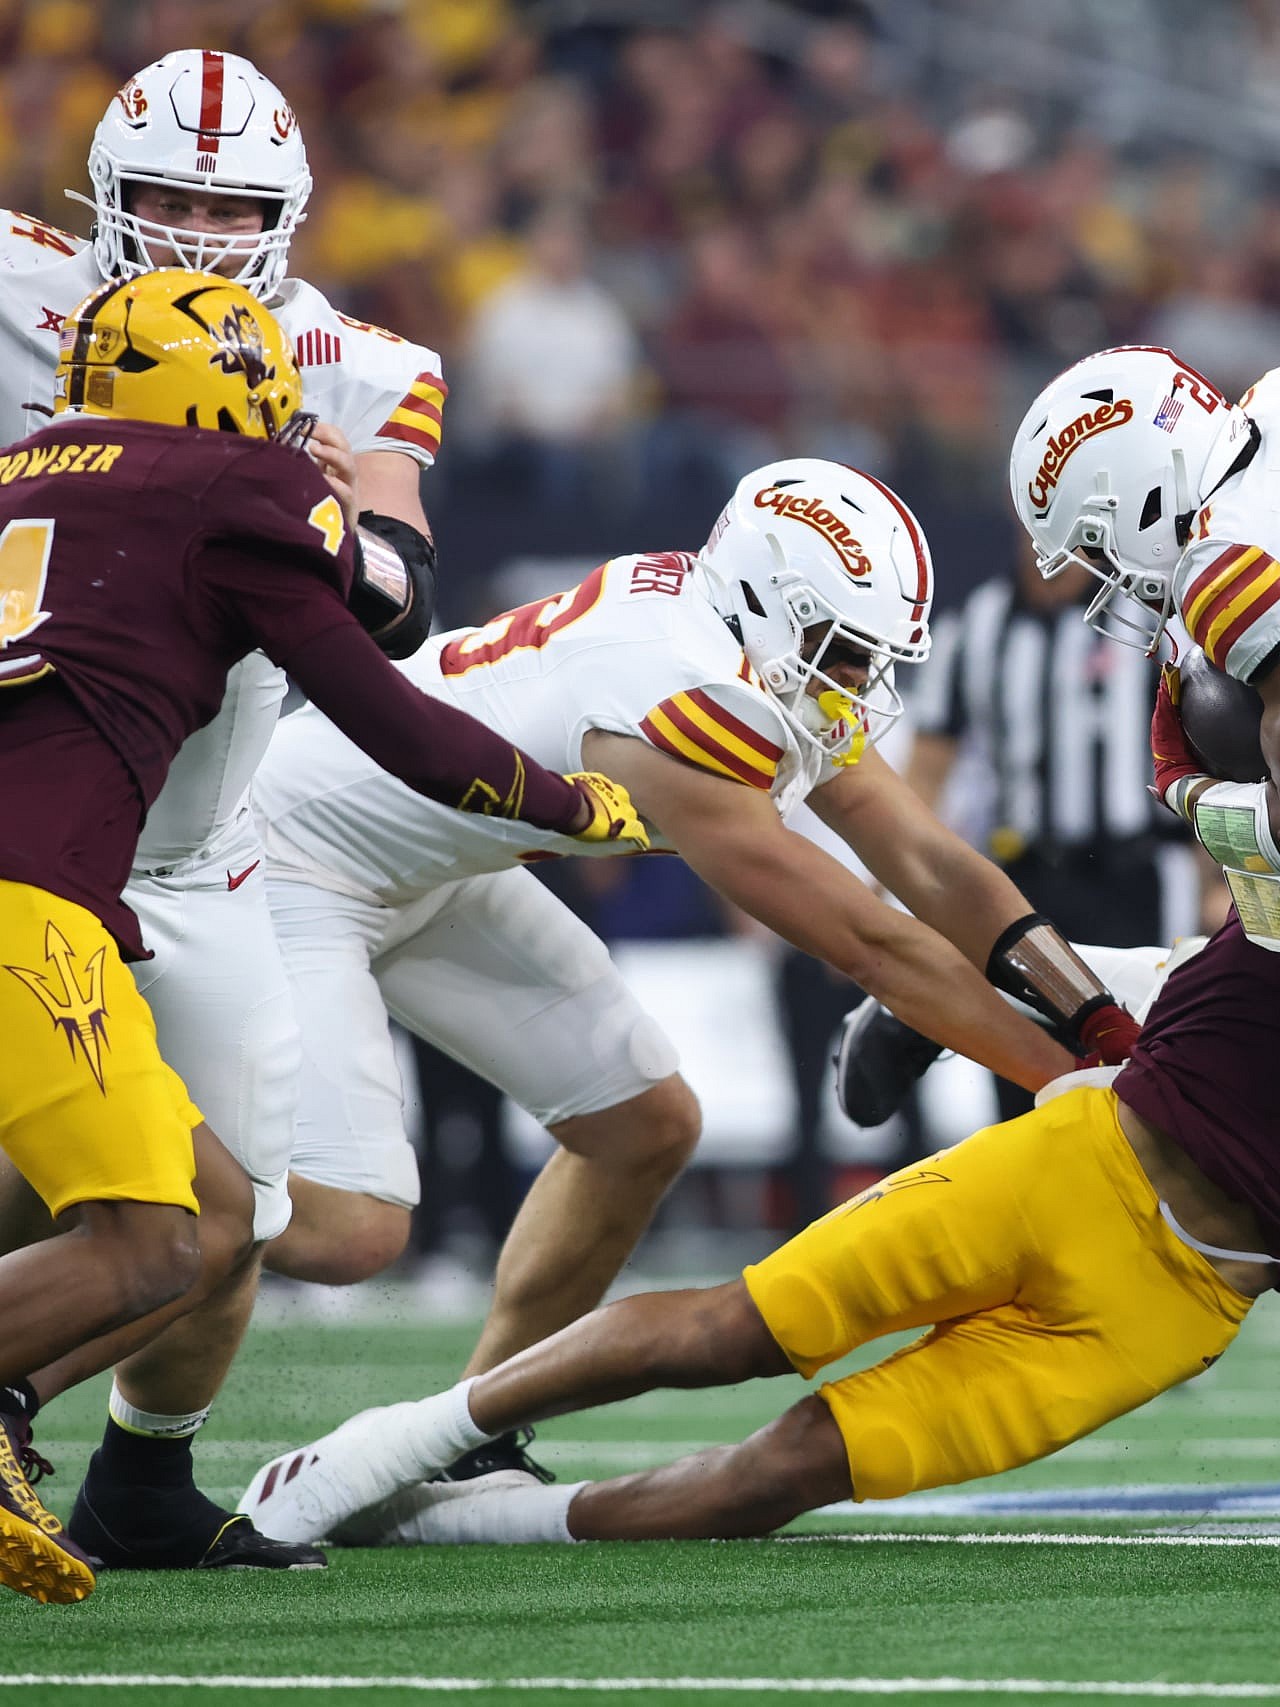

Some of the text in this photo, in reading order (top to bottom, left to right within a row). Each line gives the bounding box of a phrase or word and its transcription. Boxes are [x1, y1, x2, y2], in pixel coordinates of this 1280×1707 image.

[1028, 399, 1134, 509] Cyclones
[307, 494, 346, 557] 4
[754, 486, 872, 577] Cyclones
